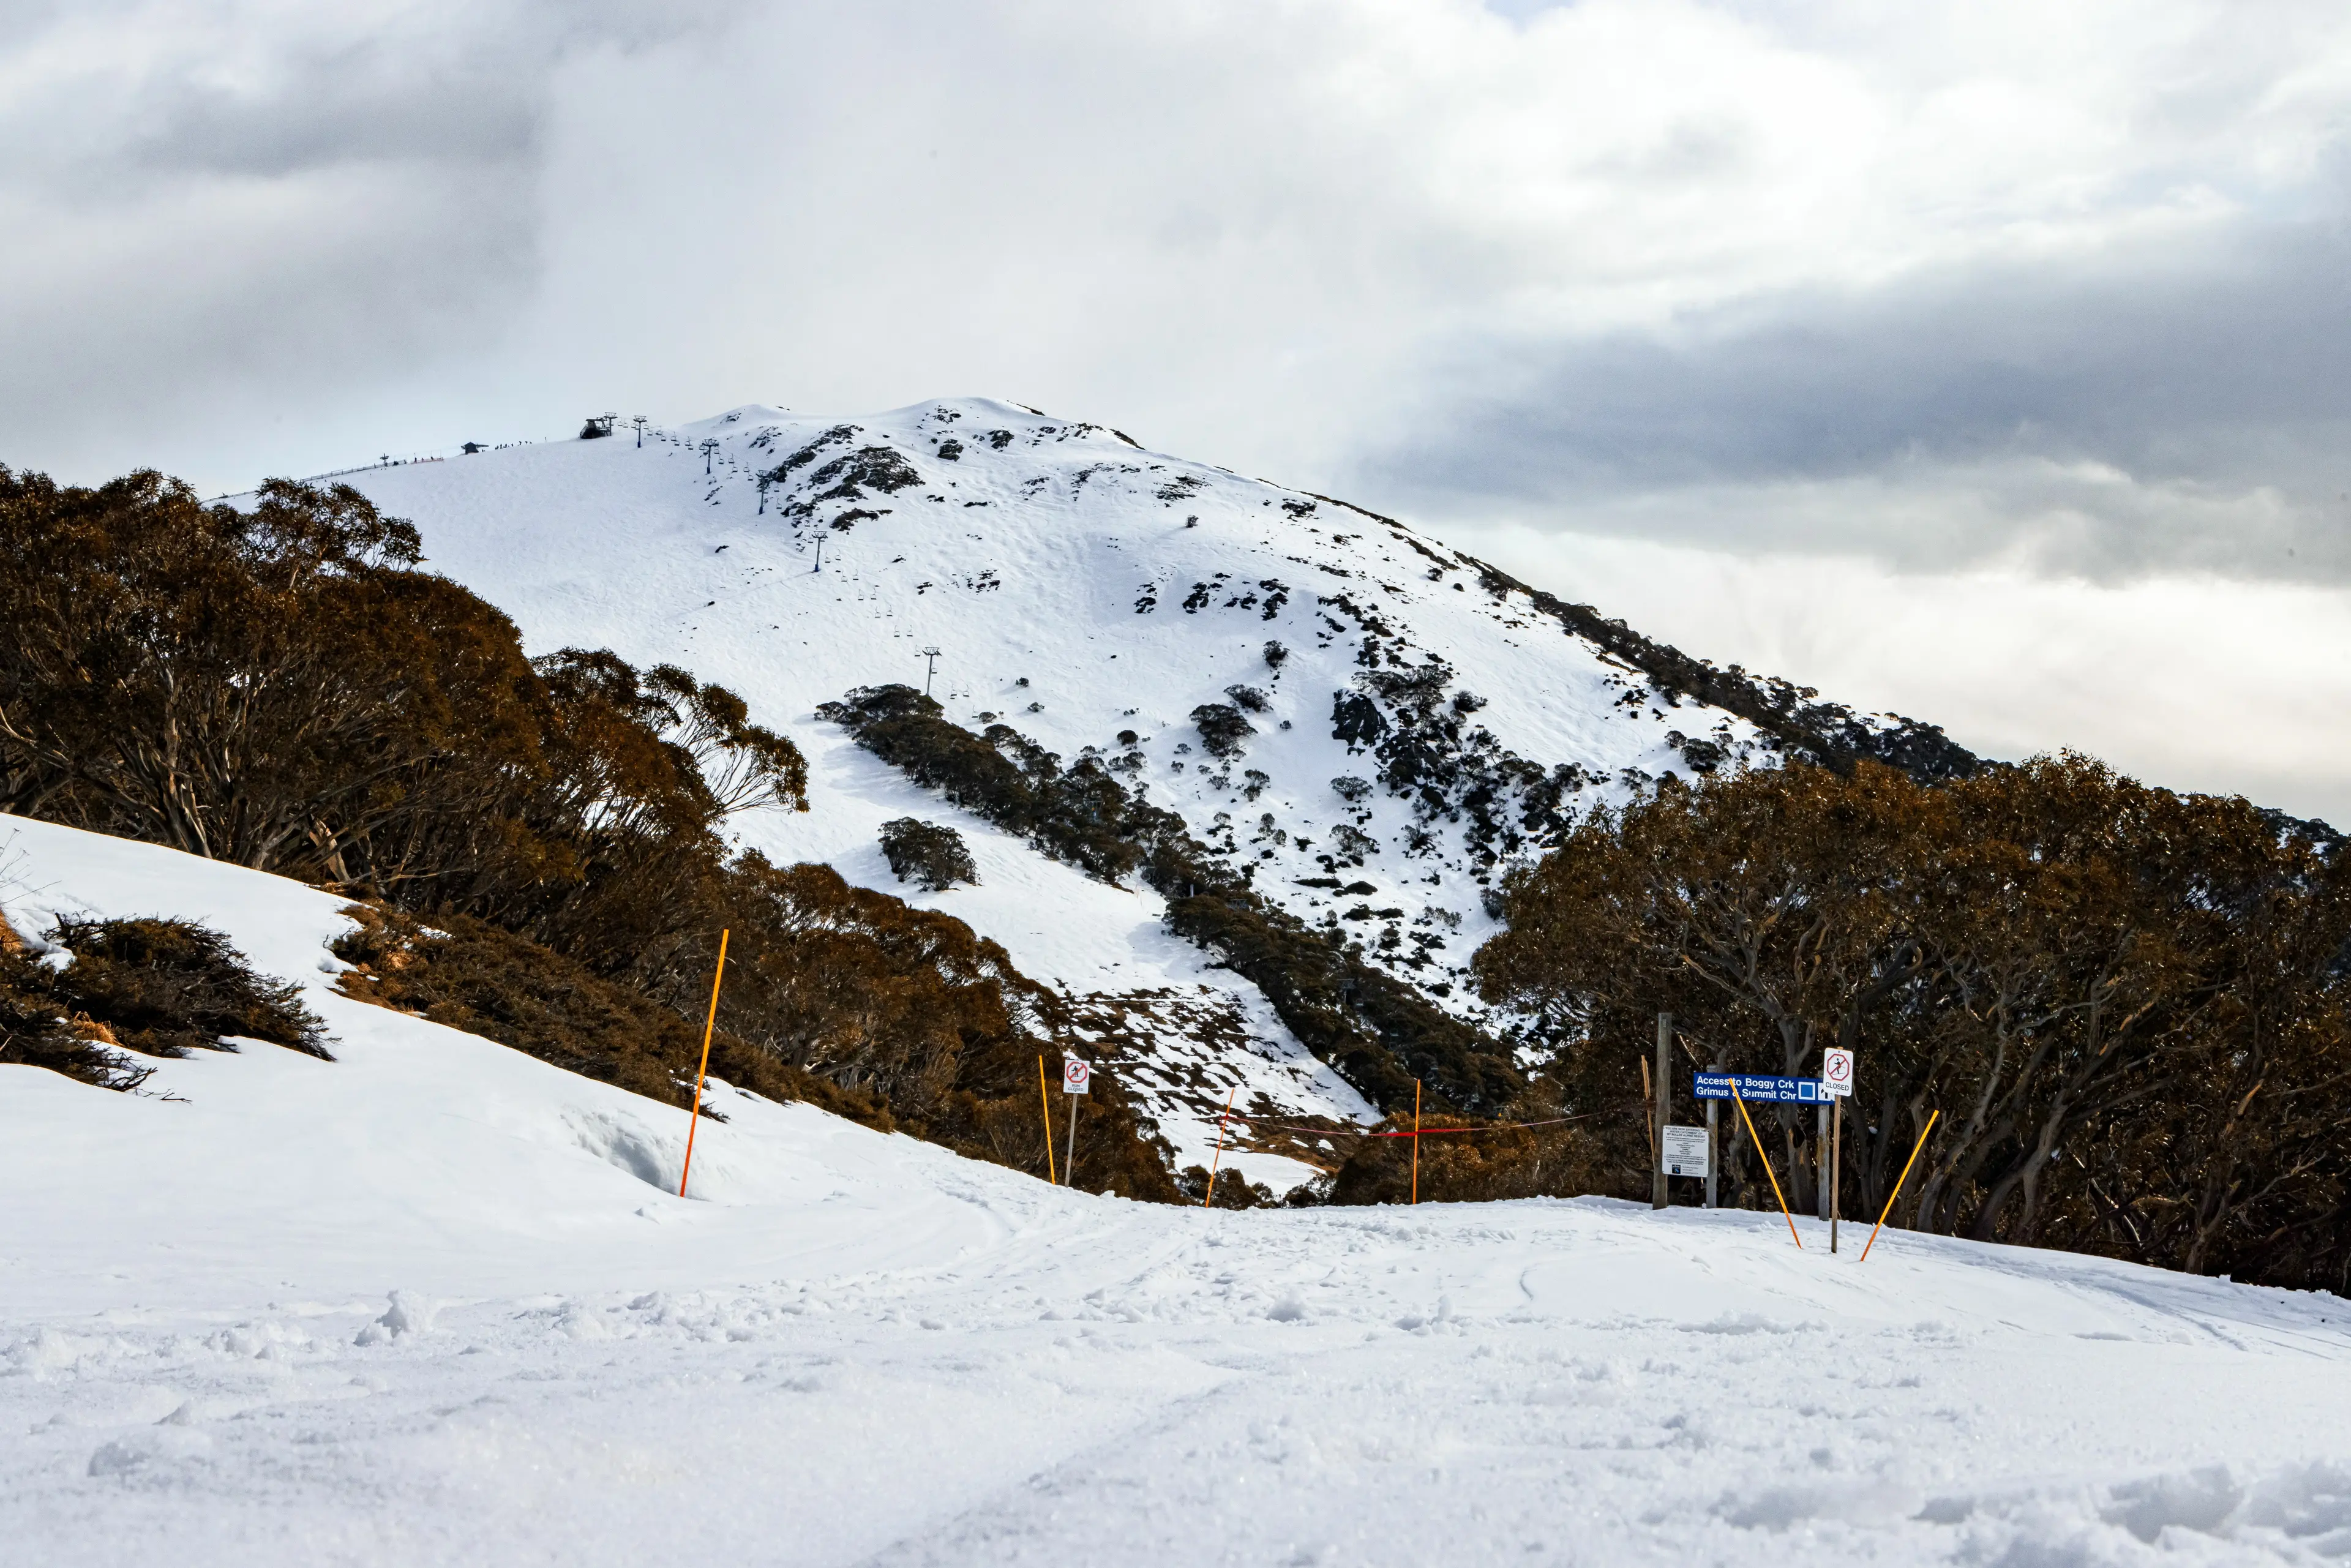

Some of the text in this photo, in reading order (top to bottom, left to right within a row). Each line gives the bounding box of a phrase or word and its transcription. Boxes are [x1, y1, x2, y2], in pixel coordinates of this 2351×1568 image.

[1697, 1076, 1794, 1089] Access to Boggy Crk
[1825, 1082, 1849, 1091] CLOSED
[1697, 1086, 1729, 1097] Grimus
[1742, 1089, 1777, 1098] Summit
[1780, 1090, 1797, 1100] Chr
